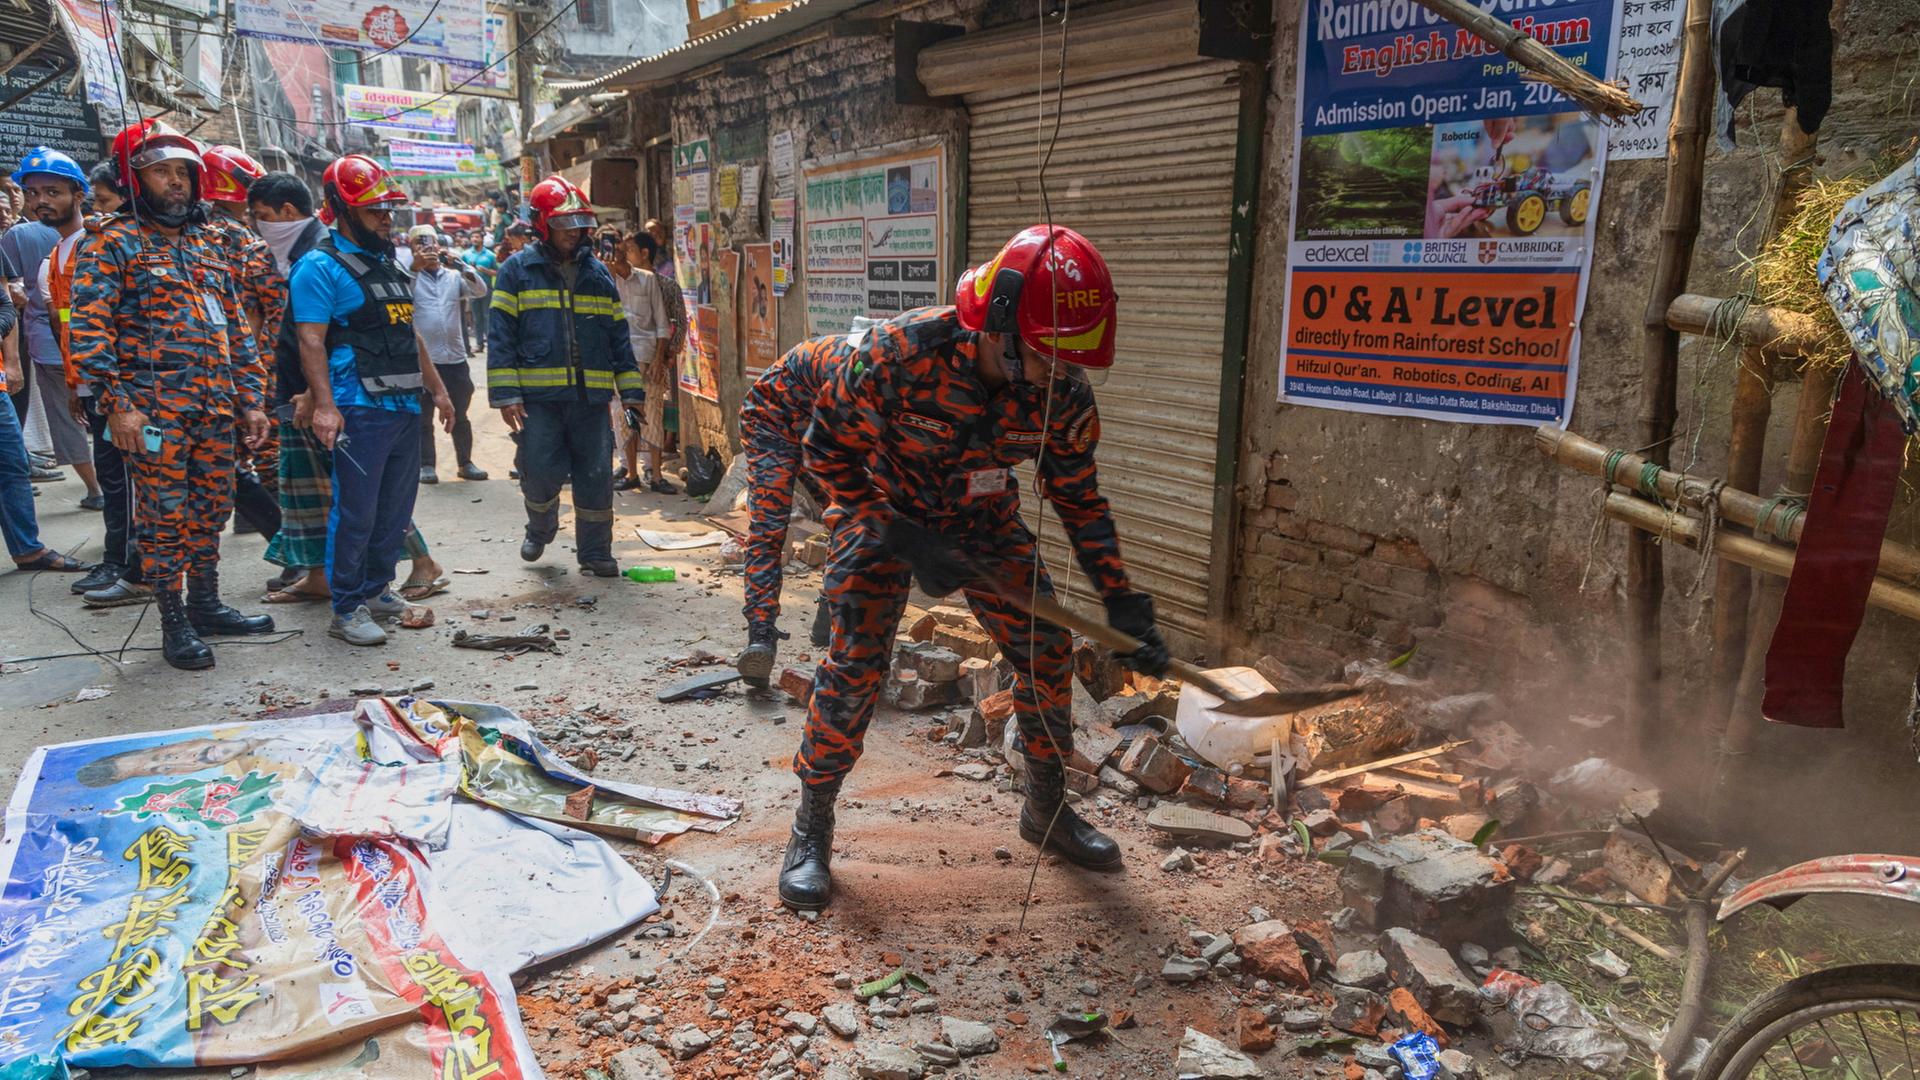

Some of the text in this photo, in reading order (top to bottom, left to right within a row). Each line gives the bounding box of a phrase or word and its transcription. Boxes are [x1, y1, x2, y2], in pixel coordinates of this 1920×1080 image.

[1647, 20, 1674, 36] হবে
[1342, 15, 1591, 77] English Mium
[1483, 62, 1503, 77] Pre
[1506, 60, 1530, 76] Pla
[1637, 72, 1669, 94] রুম
[1315, 98, 1406, 127] Admission
[1411, 94, 1468, 122] Open:
[1473, 88, 1516, 112] Jan,
[1441, 130, 1480, 143] Robotics
[1307, 229, 1339, 237] Rainforest
[1354, 227, 1383, 236] towards
[1305, 245, 1369, 263] edexcel
[1424, 242, 1467, 253] BRITISH
[1498, 241, 1565, 253] CAMBRIDGE
[1423, 252, 1468, 264] COUNCIL
[1056, 288, 1101, 309] FIRE
[1344, 285, 1373, 323] &
[1431, 286, 1557, 329] Level
[1295, 326, 1560, 358] directly from Rainforest School
[1296, 359, 1331, 374] Hifzul
[1393, 366, 1461, 387] Robotics,
[1465, 371, 1527, 393] Coding,
[1531, 375, 1550, 391] AI
[1306, 383, 1332, 395] Horonath
[1333, 385, 1352, 396] Ghosh
[1353, 387, 1371, 398] Road,
[1372, 389, 1397, 403] Lalbagh
[1415, 393, 1439, 405] Umesh
[1439, 396, 1458, 407] Dutta
[1459, 397, 1480, 410] Road,
[1481, 399, 1529, 414] Bakshibazar,
[1530, 403, 1557, 415] Dhaka
[289, 838, 312, 873] নগদ
